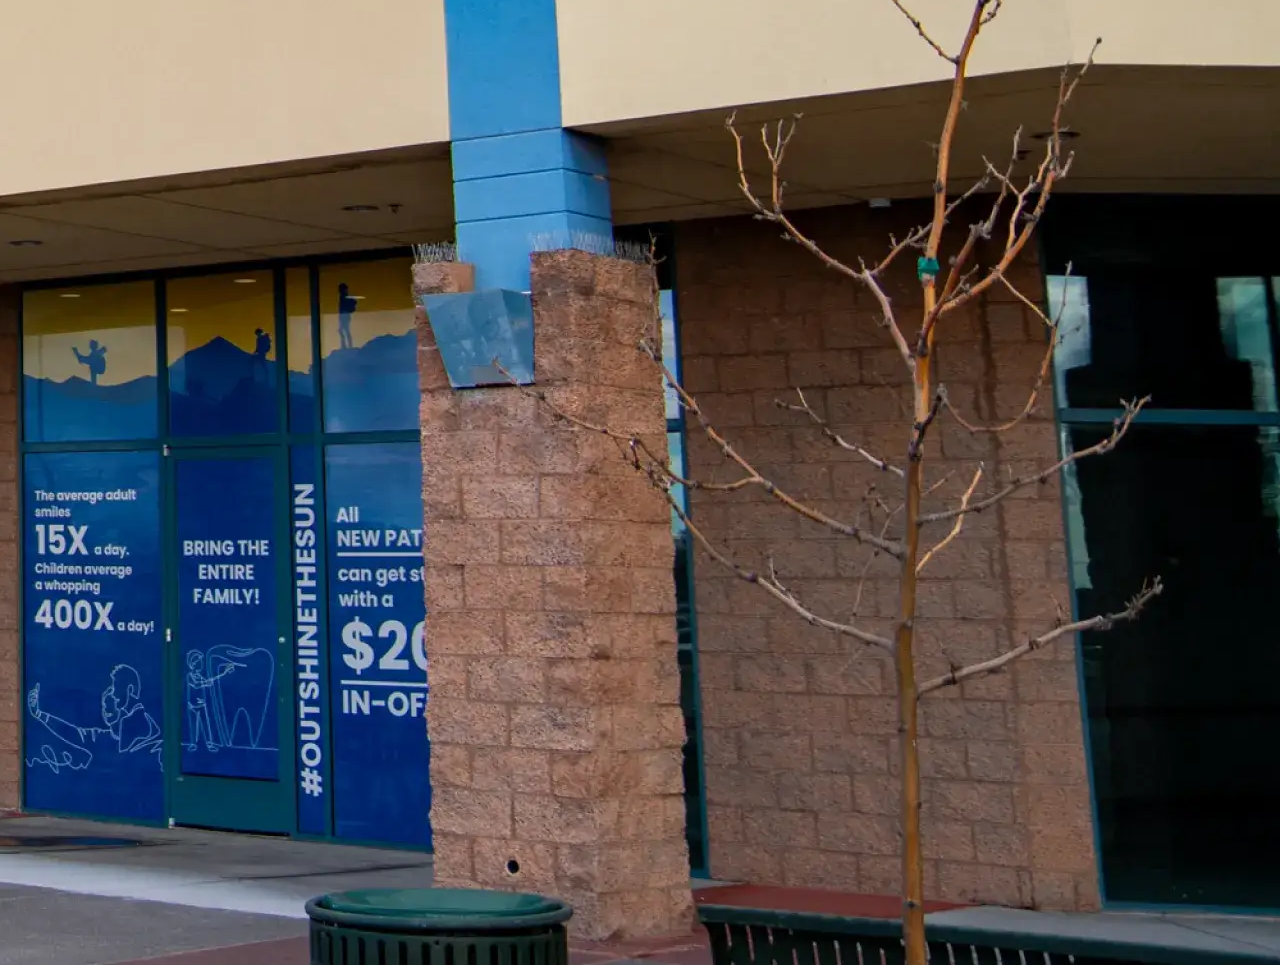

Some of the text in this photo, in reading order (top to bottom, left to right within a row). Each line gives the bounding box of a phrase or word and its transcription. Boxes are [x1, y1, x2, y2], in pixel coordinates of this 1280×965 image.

[34, 488, 137, 504] The average adult
[34, 505, 71, 518] smiles
[336, 506, 359, 524] All
[34, 524, 130, 559] 15X a day.
[337, 529, 381, 547] NEW
[183, 540, 269, 556] BRING THE
[34, 561, 133, 579] Children average
[198, 564, 255, 581] ENTIRE
[337, 568, 372, 582] can
[375, 565, 407, 587] get
[34, 579, 100, 595] a whopping
[193, 588, 260, 604] FAMILY!
[338, 589, 394, 608] with a
[34, 598, 155, 635] 400X a day!
[293, 483, 324, 798] #OUTSHINETHESUN
